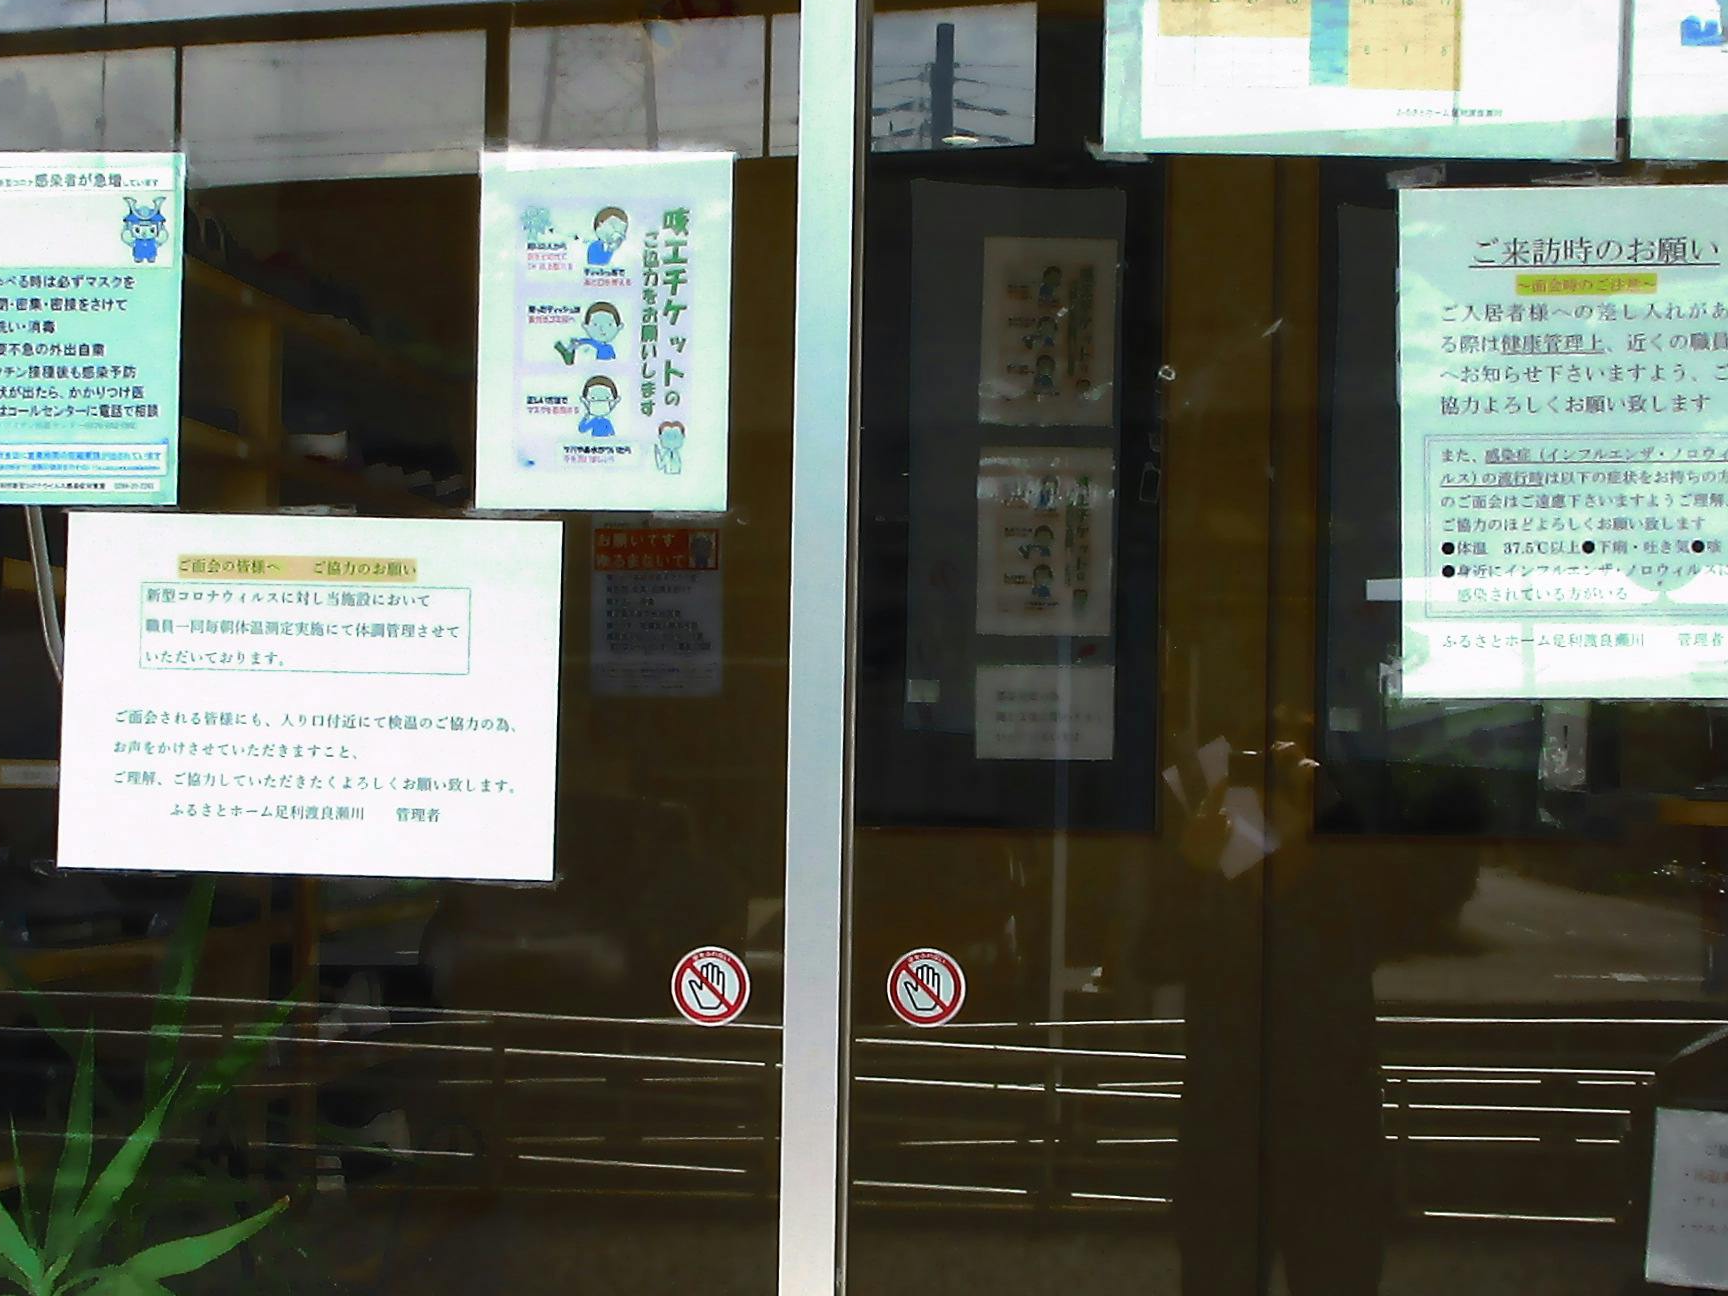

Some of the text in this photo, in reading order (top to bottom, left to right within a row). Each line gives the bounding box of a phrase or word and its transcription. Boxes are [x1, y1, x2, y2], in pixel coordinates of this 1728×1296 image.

[1474, 236, 1720, 266] ご来訪時のお願い
[662, 207, 691, 408] 咳エチケットの
[639, 230, 660, 418] ご協力をお願いします
[1440, 393, 1712, 415] 協力よろしくお願い致します
[1440, 516, 1706, 533] ご協力のほどよろしくお願い致します
[178, 558, 417, 578] ご面会の皆様へ ご協力のお願い
[145, 587, 431, 608] 新型コロナウィルスに対し当施設において
[145, 618, 460, 640] 職員一同毎朝体温測定実施にて体調管理させて
[145, 649, 286, 667] いただいております。
[114, 709, 517, 733] ご面会される皆様にも、入り口付近にて検温のご協力の為、
[113, 740, 361, 760] お声をかけさせていただきますこと、
[113, 770, 517, 794] ご理解、ご協力していただきたくよろしくお願い致します。
[170, 803, 442, 824] ふるさとホーム足利渡良瀬川 管理者
